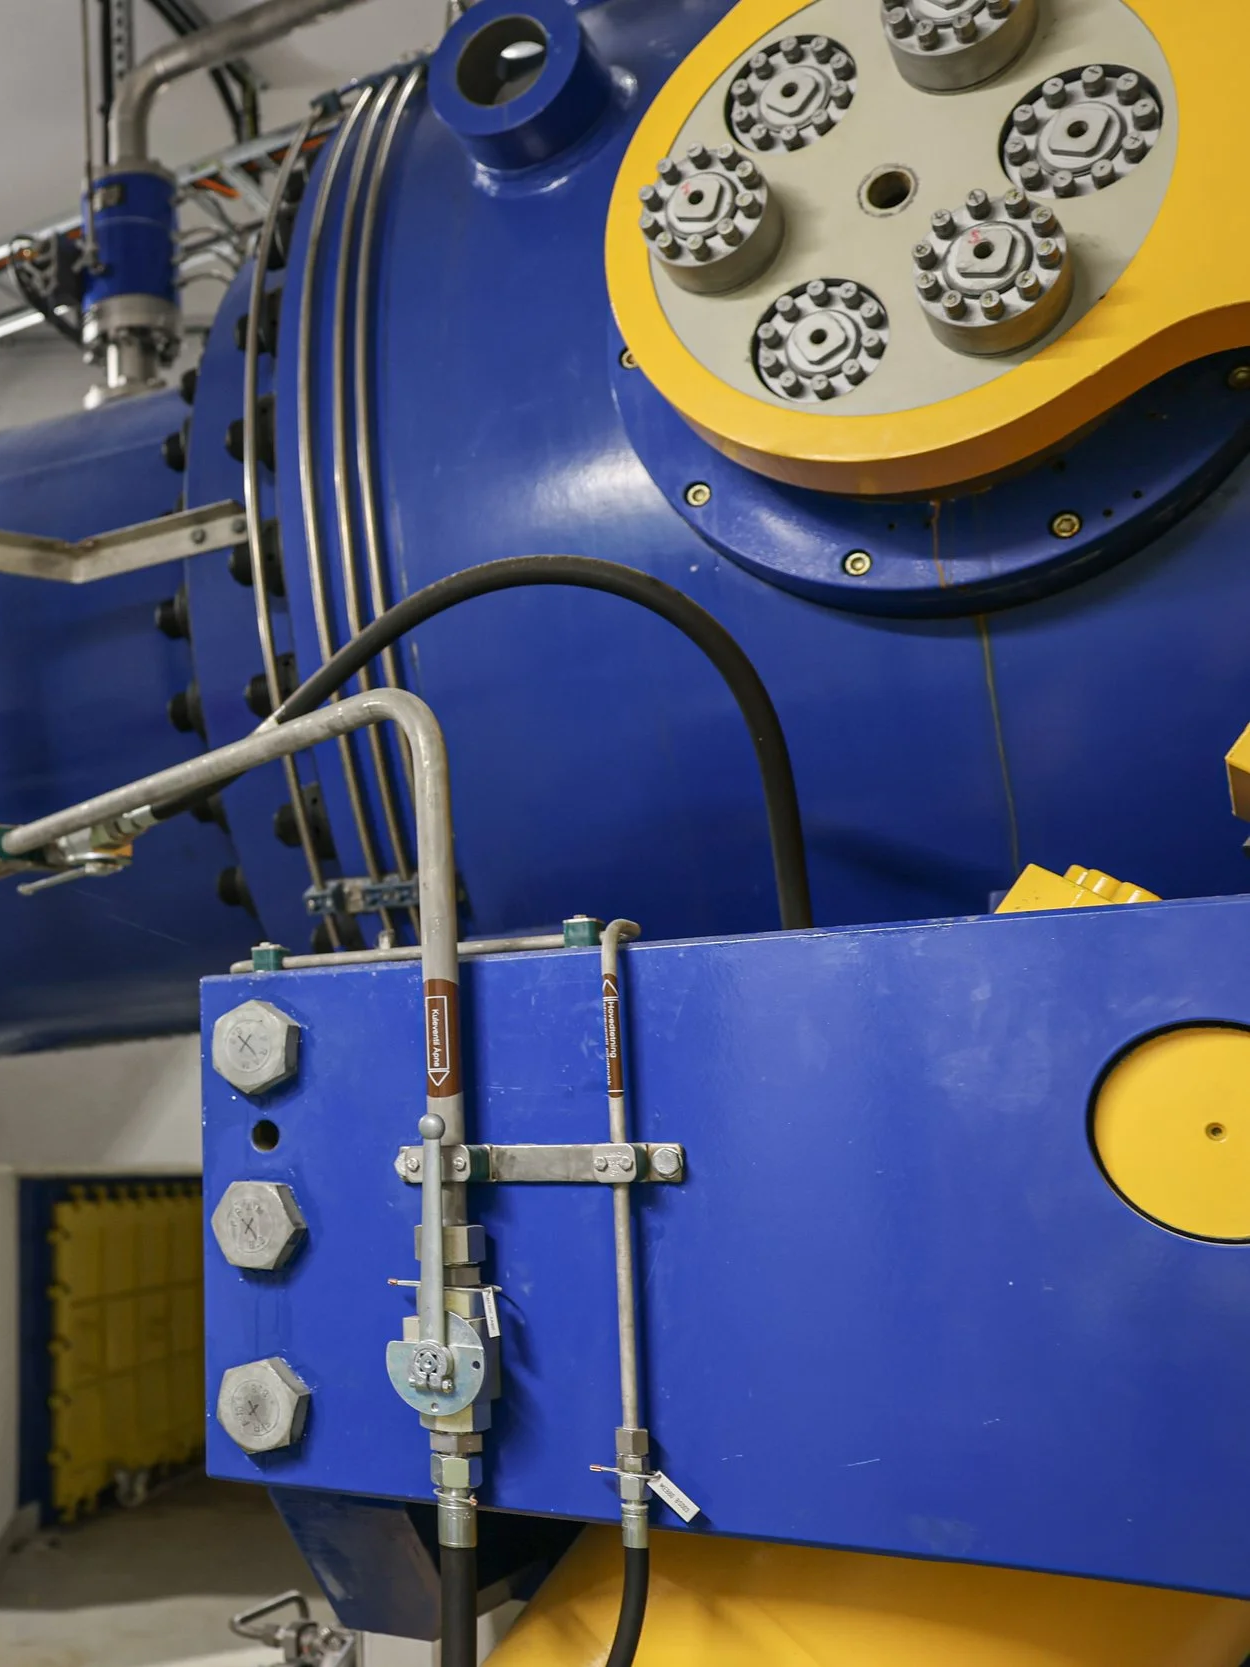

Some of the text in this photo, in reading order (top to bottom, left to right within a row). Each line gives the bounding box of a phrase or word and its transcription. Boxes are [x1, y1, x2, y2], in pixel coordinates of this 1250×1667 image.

[431, 1008, 442, 1067] Kuleventil Åpne
[607, 1001, 617, 1058] Hovedtetning
